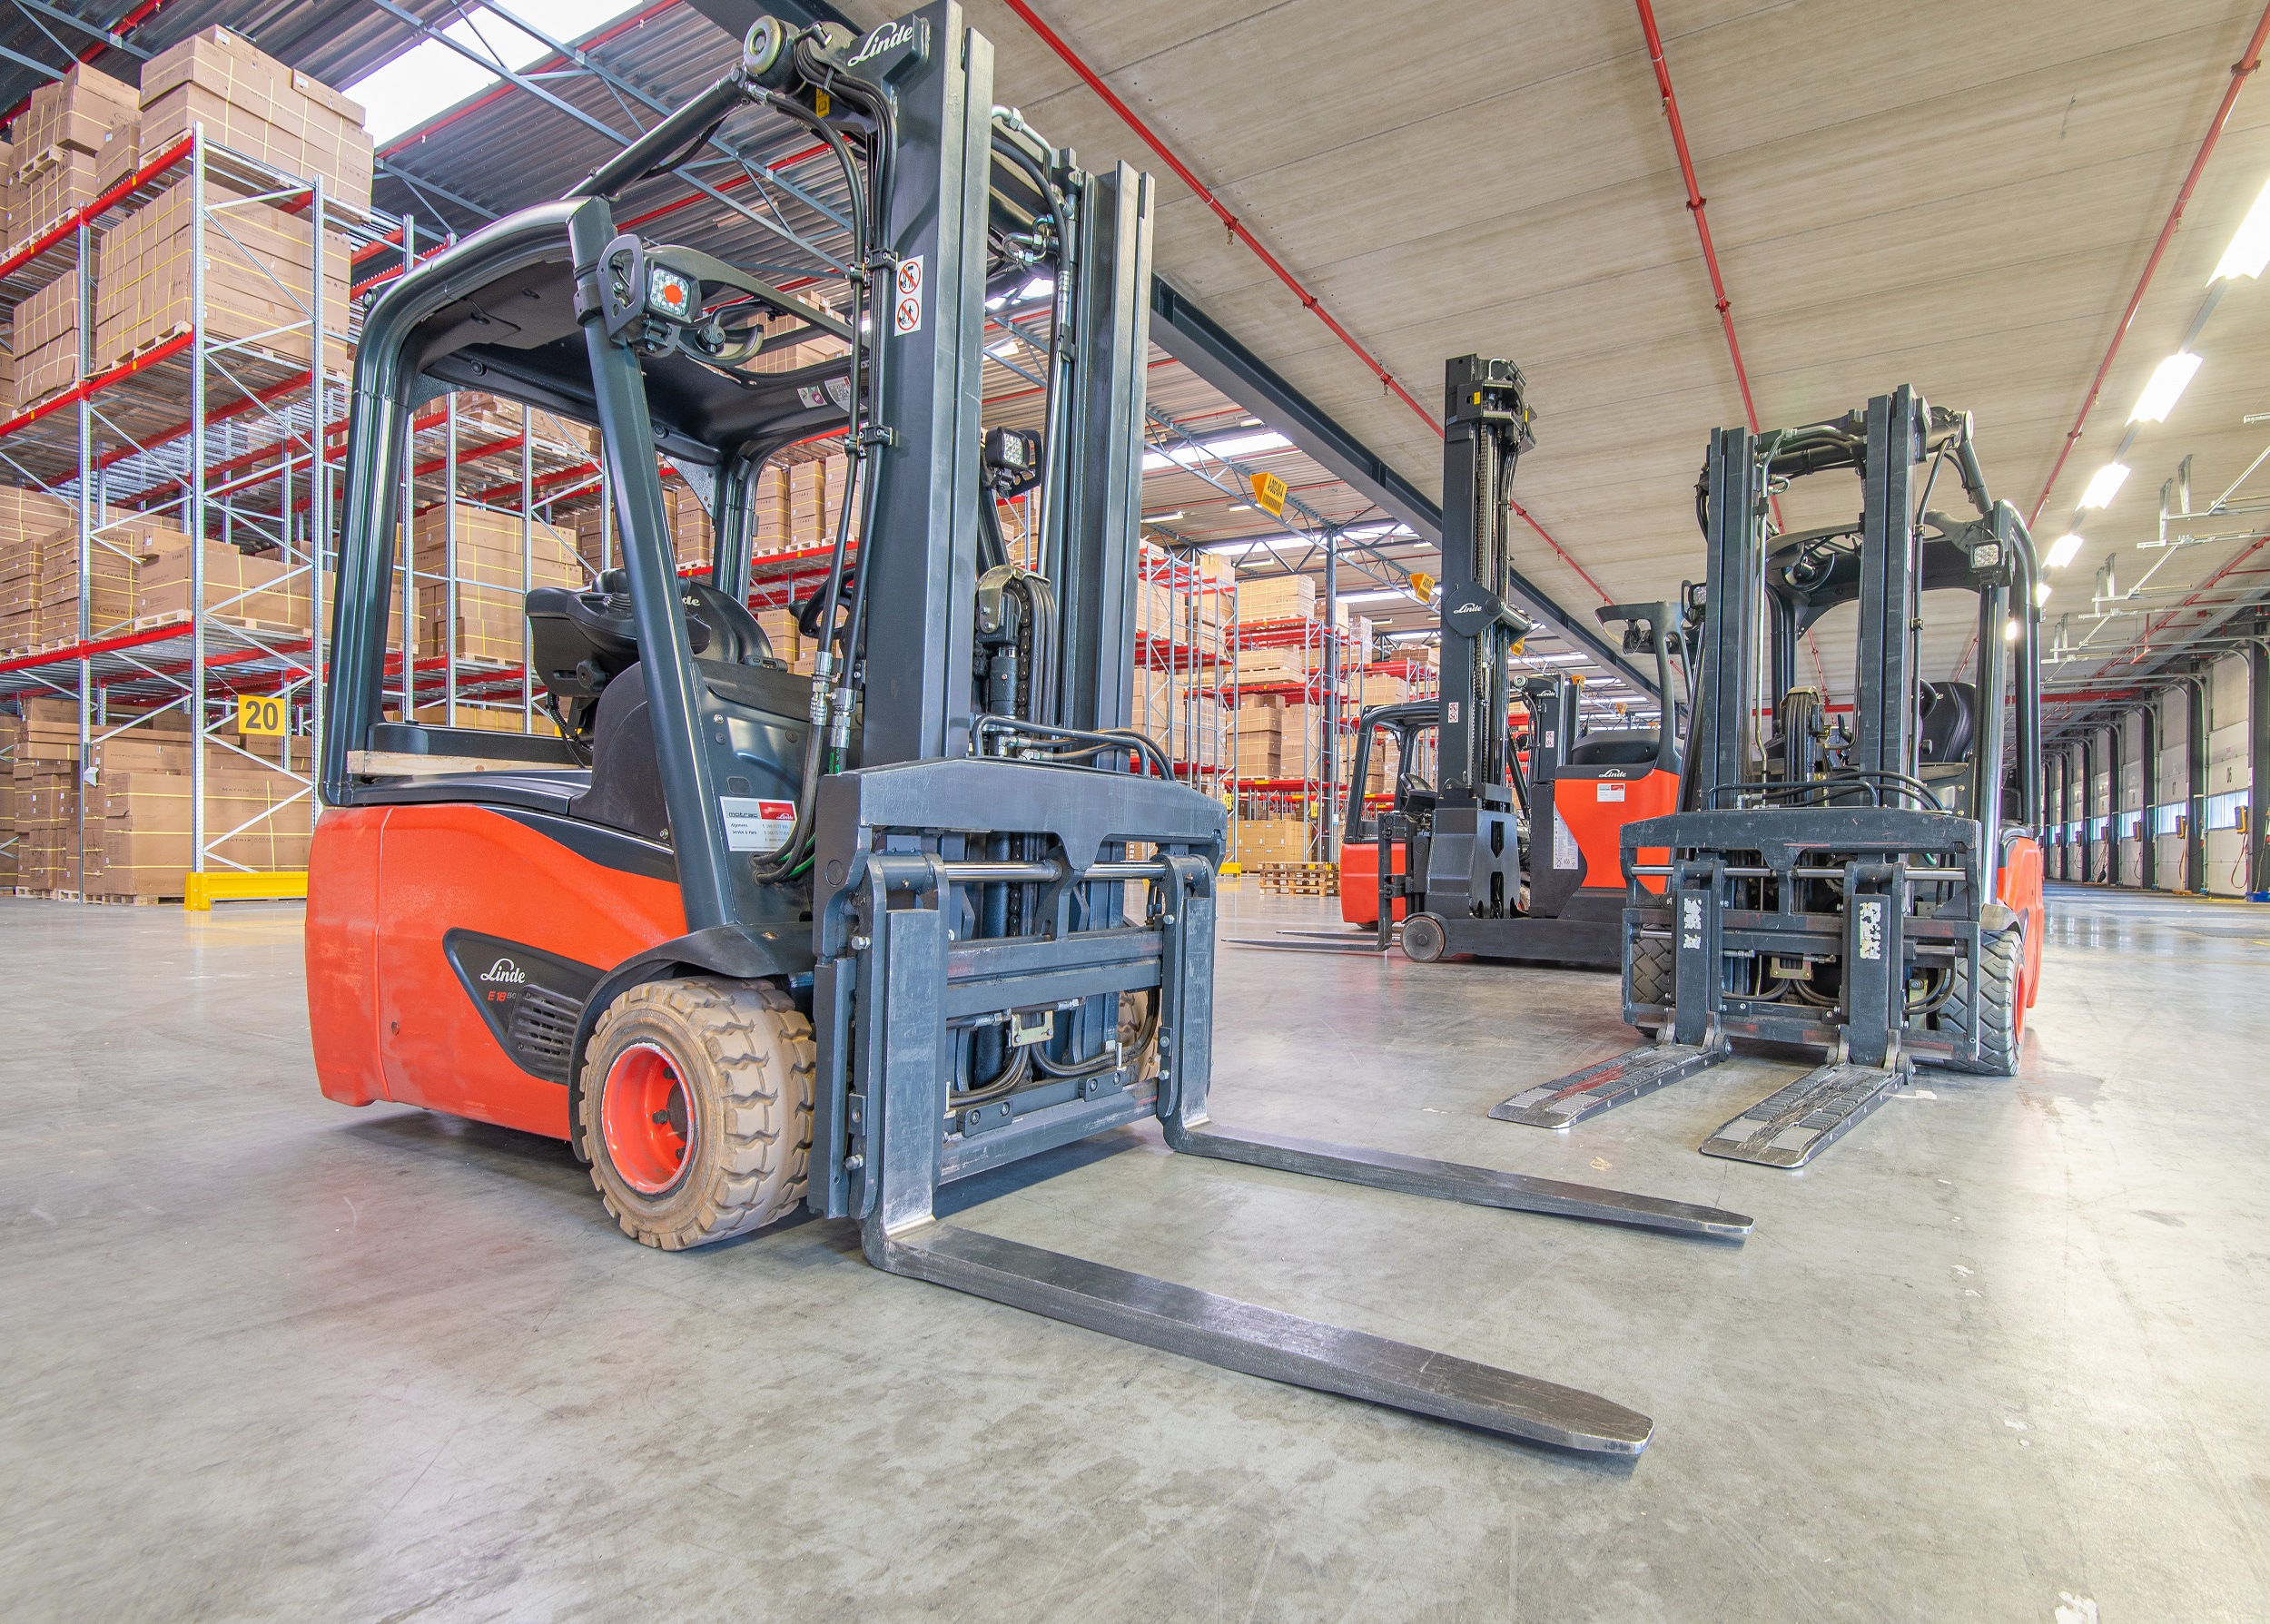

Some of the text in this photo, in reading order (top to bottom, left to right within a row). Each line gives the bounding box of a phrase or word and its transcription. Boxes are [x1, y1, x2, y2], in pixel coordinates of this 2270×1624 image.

[847, 22, 913, 67] Linde
[103, 607, 133, 615] MATRI
[1453, 603, 1483, 615] Linde
[1536, 689, 1556, 697] Linde
[245, 700, 280, 731] 20
[1598, 768, 1627, 778] Linde
[479, 958, 526, 984] Linde
